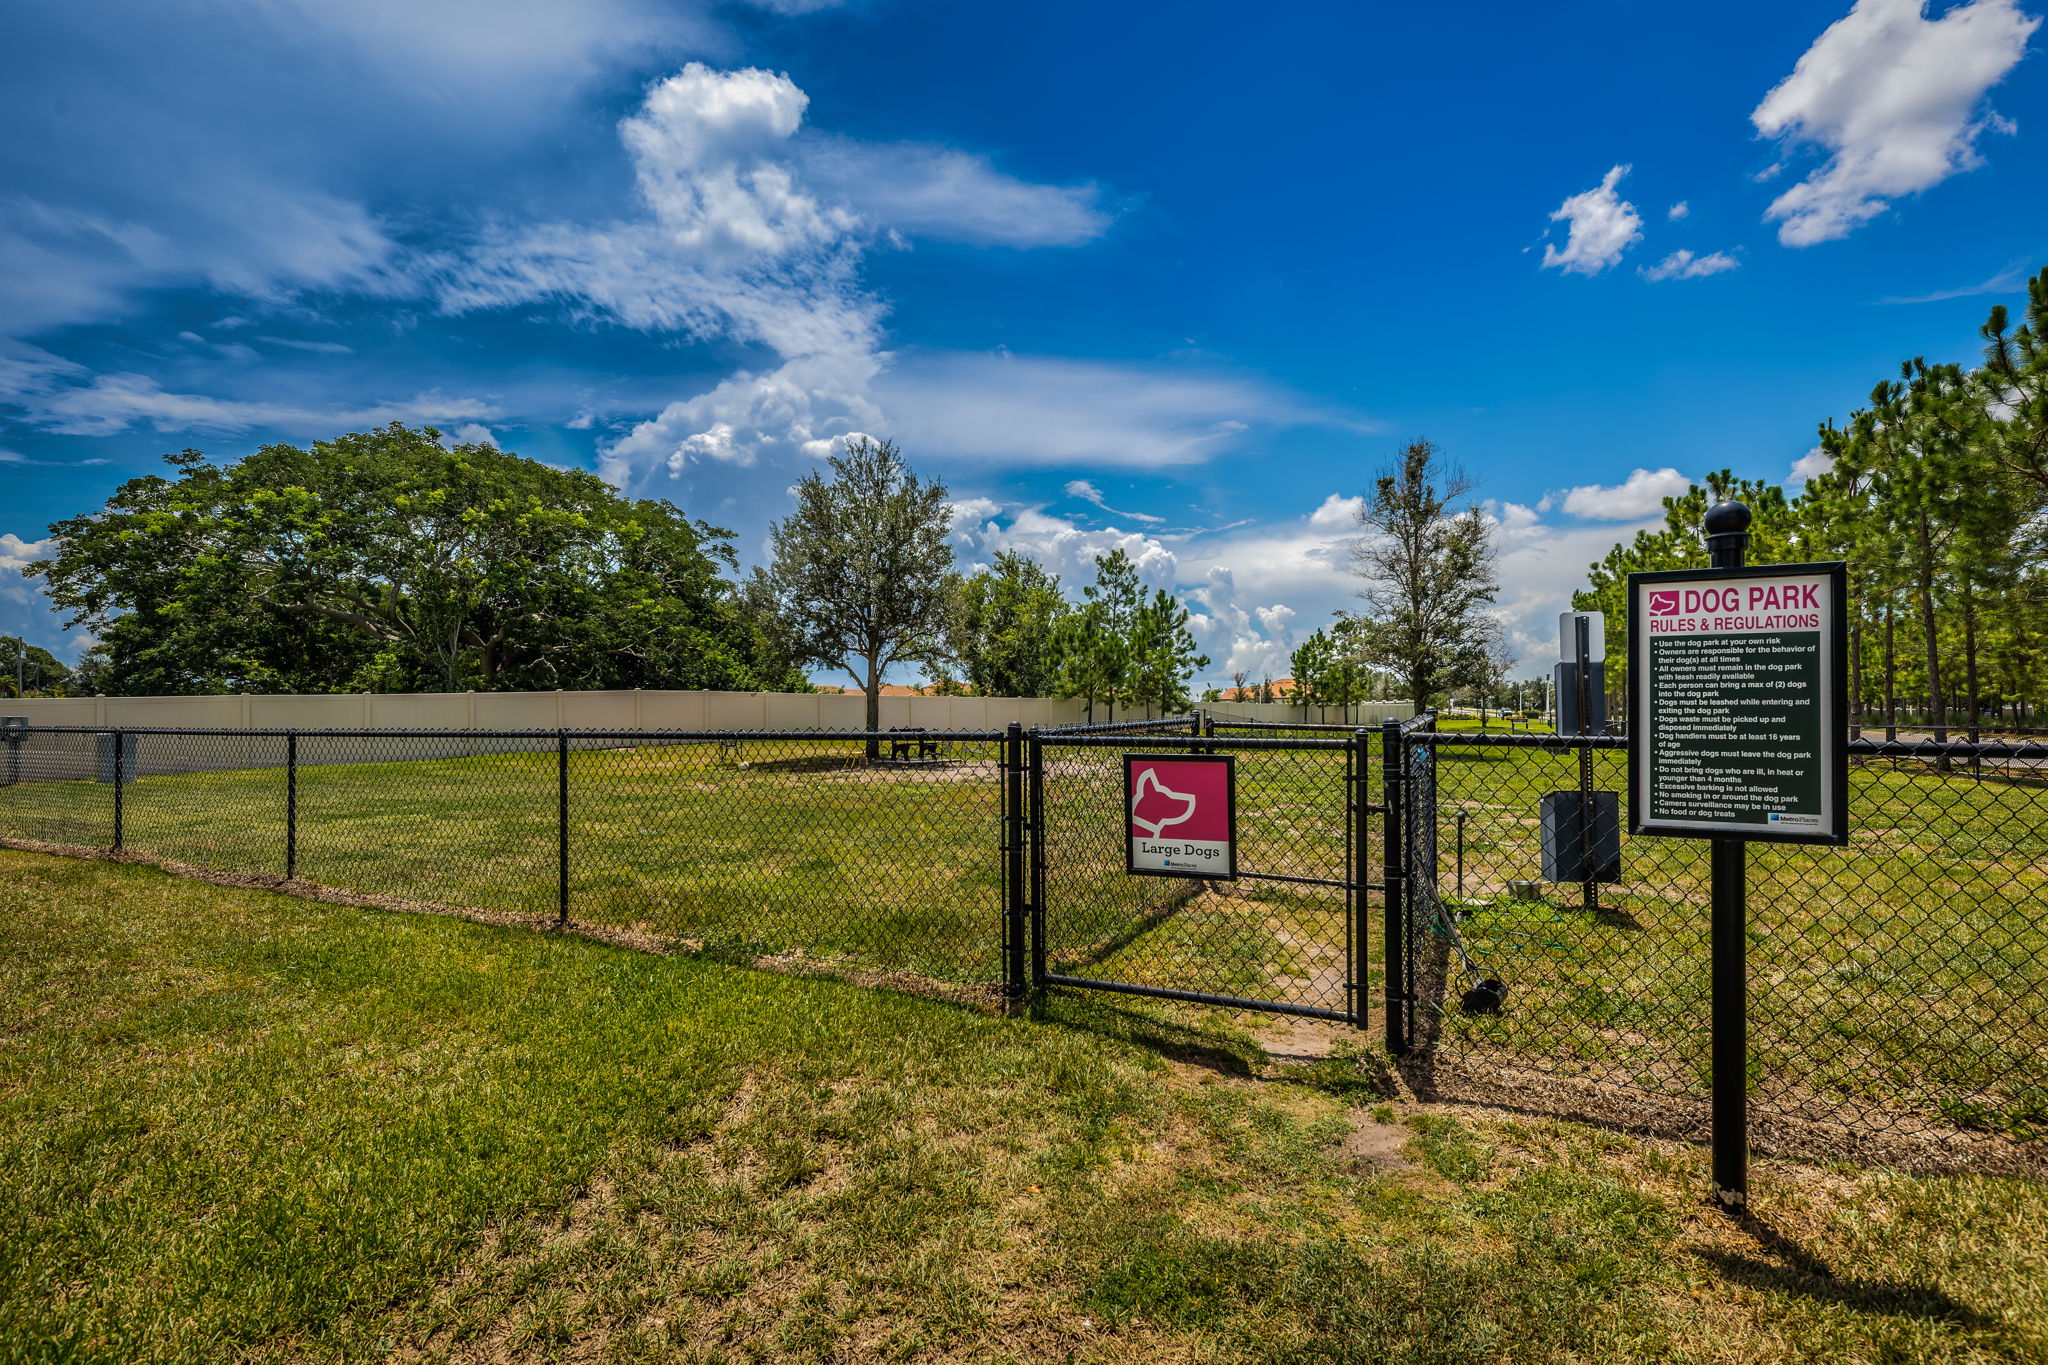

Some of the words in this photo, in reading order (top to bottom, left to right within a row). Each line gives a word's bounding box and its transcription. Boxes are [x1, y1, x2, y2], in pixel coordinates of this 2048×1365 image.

[1685, 588, 1739, 613] DOG
[1749, 584, 1820, 610] PARK
[1651, 619, 1695, 632] RULES
[1700, 618, 1709, 631] &
[1714, 614, 1819, 630] REGULATIONS
[1701, 647, 1743, 655] responsible
[1676, 656, 1699, 664] dog(s)
[1697, 784, 1724, 792] barking
[1671, 792, 1702, 800] smoking
[1142, 842, 1180, 857] Large
[1185, 845, 1220, 859] Dogs
